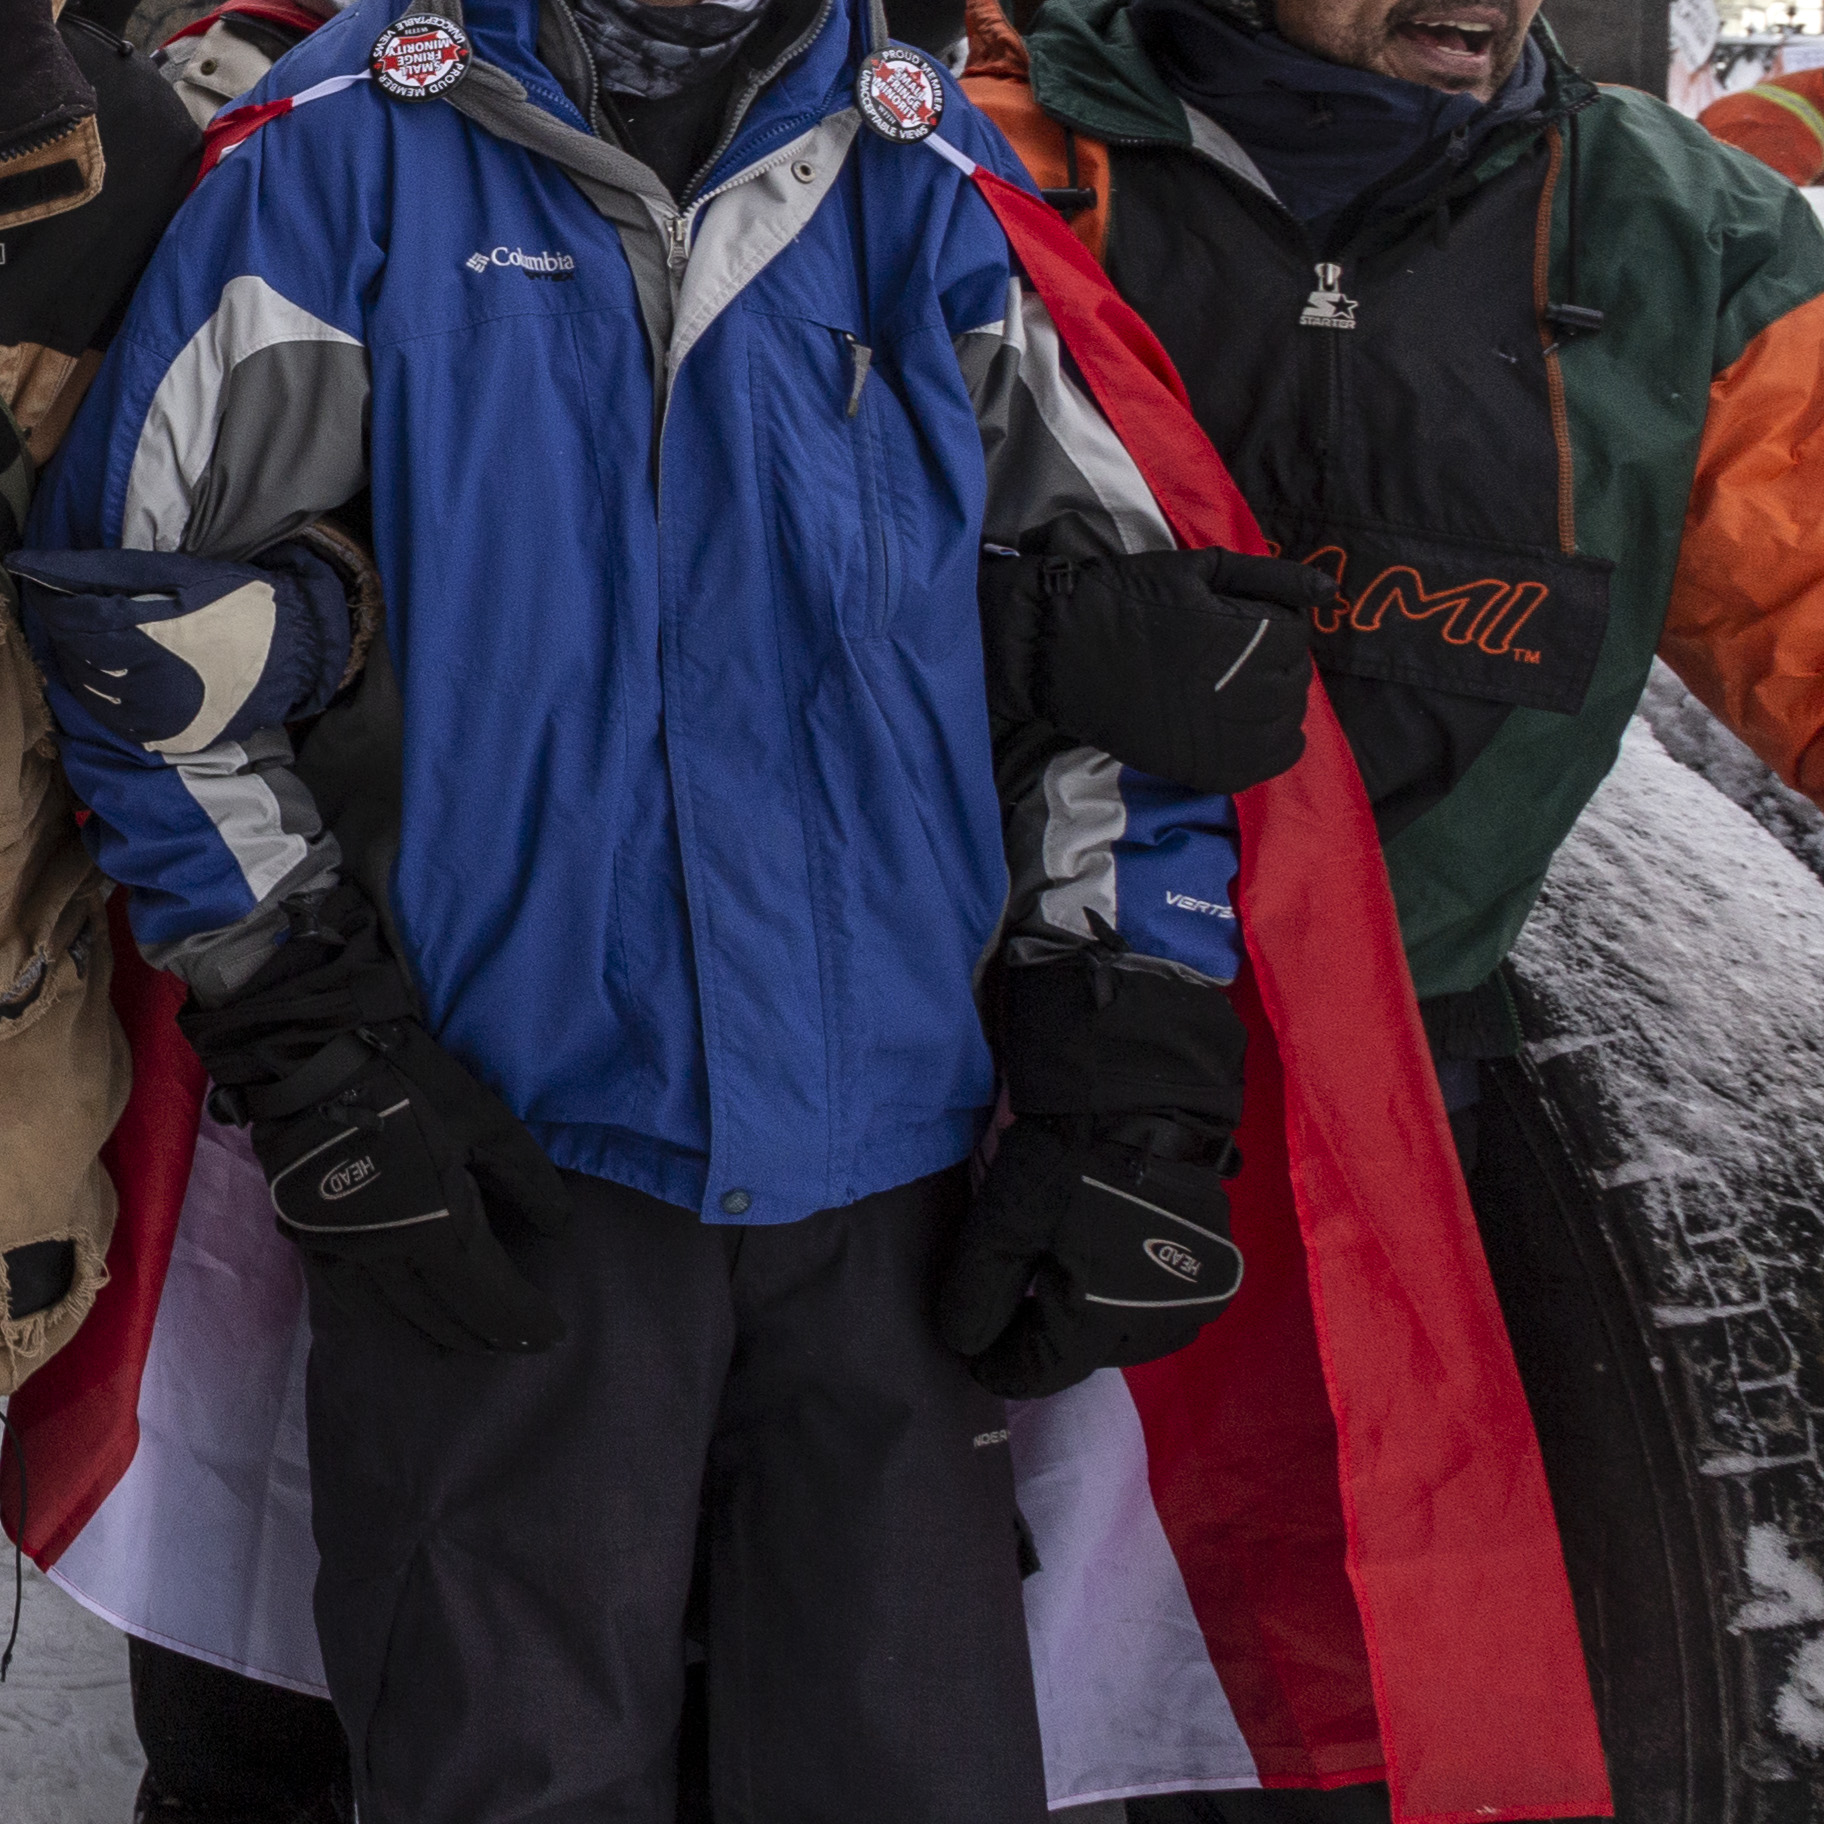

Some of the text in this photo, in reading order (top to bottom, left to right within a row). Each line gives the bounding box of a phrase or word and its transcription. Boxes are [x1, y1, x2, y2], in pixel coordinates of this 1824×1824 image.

[373, 16, 466, 58] UNACCEPTABLE VIEWS
[405, 27, 429, 35] WITH
[387, 38, 450, 57] MINORITY
[397, 50, 442, 66] FRINGE
[378, 63, 465, 97] PROUD MEMBER
[400, 60, 442, 76] SMALL
[882, 49, 943, 112] PROUD MEMBER
[886, 74, 921, 112] FRINGE
[894, 67, 926, 101] SMALL
[860, 69, 929, 139] UNACCEPTABLE VIEWS
[872, 77, 922, 124] MINORITY
[878, 105, 896, 124] WITH
[491, 246, 575, 272] Columbia
[1299, 316, 1357, 329] STARTER
[1513, 648, 1542, 664] TM
[1166, 890, 1236, 919] VERTE
[330, 1155, 376, 1193] HEAD
[1159, 1245, 1202, 1276] HEAD
